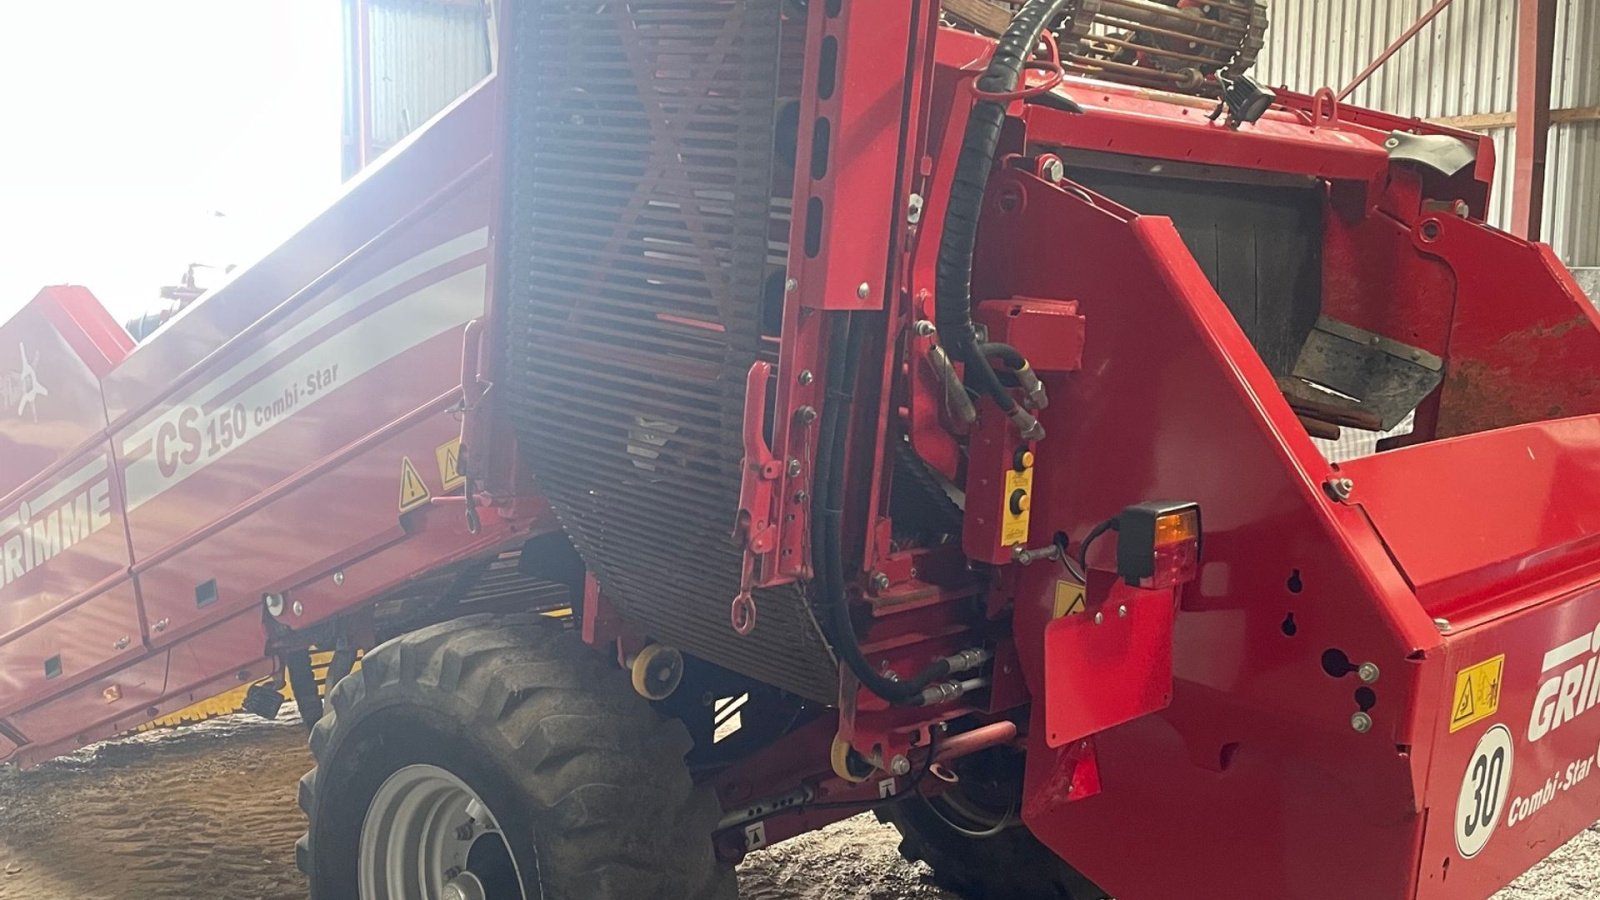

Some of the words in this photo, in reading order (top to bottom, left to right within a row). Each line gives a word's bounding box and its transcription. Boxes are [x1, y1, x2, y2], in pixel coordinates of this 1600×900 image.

[156, 406, 202, 478] CS
[206, 402, 247, 457] 150
[0, 478, 111, 590] RIMME
[1464, 746, 1504, 838] 30
[1507, 754, 1595, 828] Combi-Star
